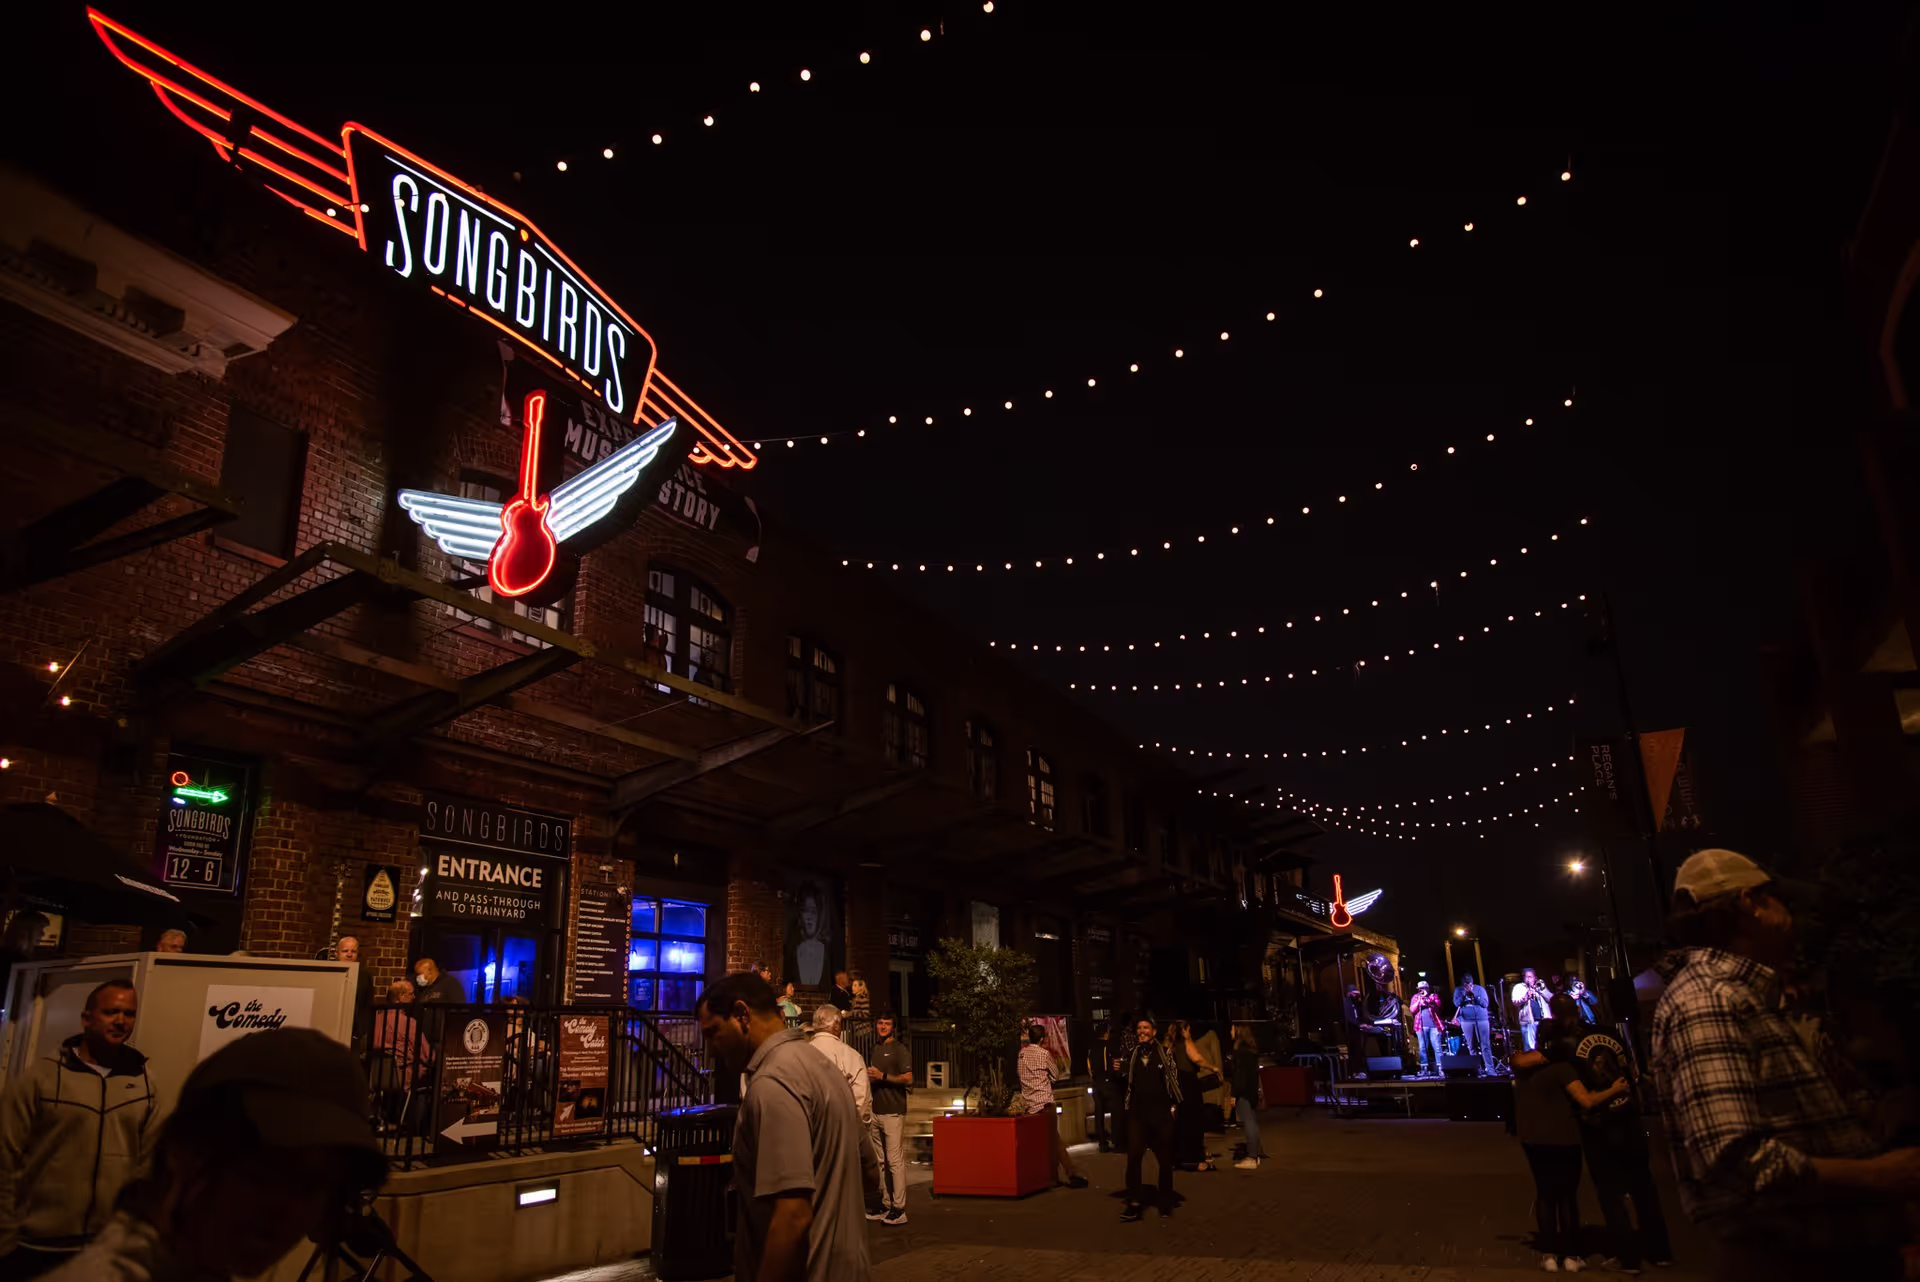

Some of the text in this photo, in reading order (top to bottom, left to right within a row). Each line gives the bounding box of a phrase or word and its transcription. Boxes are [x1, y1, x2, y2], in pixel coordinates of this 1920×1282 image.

[385, 173, 626, 414] SONGBIRDS
[1591, 745, 1604, 787] PLACE
[168, 809, 231, 839] SONGBIRDS
[426, 801, 564, 851] SONGBIRDS
[170, 857, 191, 880] 12
[204, 860, 215, 881] 6
[437, 854, 542, 888] ENTRANCE
[435, 890, 541, 910] AND PASS-THROUGH
[452, 902, 526, 919] TO TRAINYARD
[208, 1001, 287, 1029] Comedy
[244, 999, 263, 1012] the
